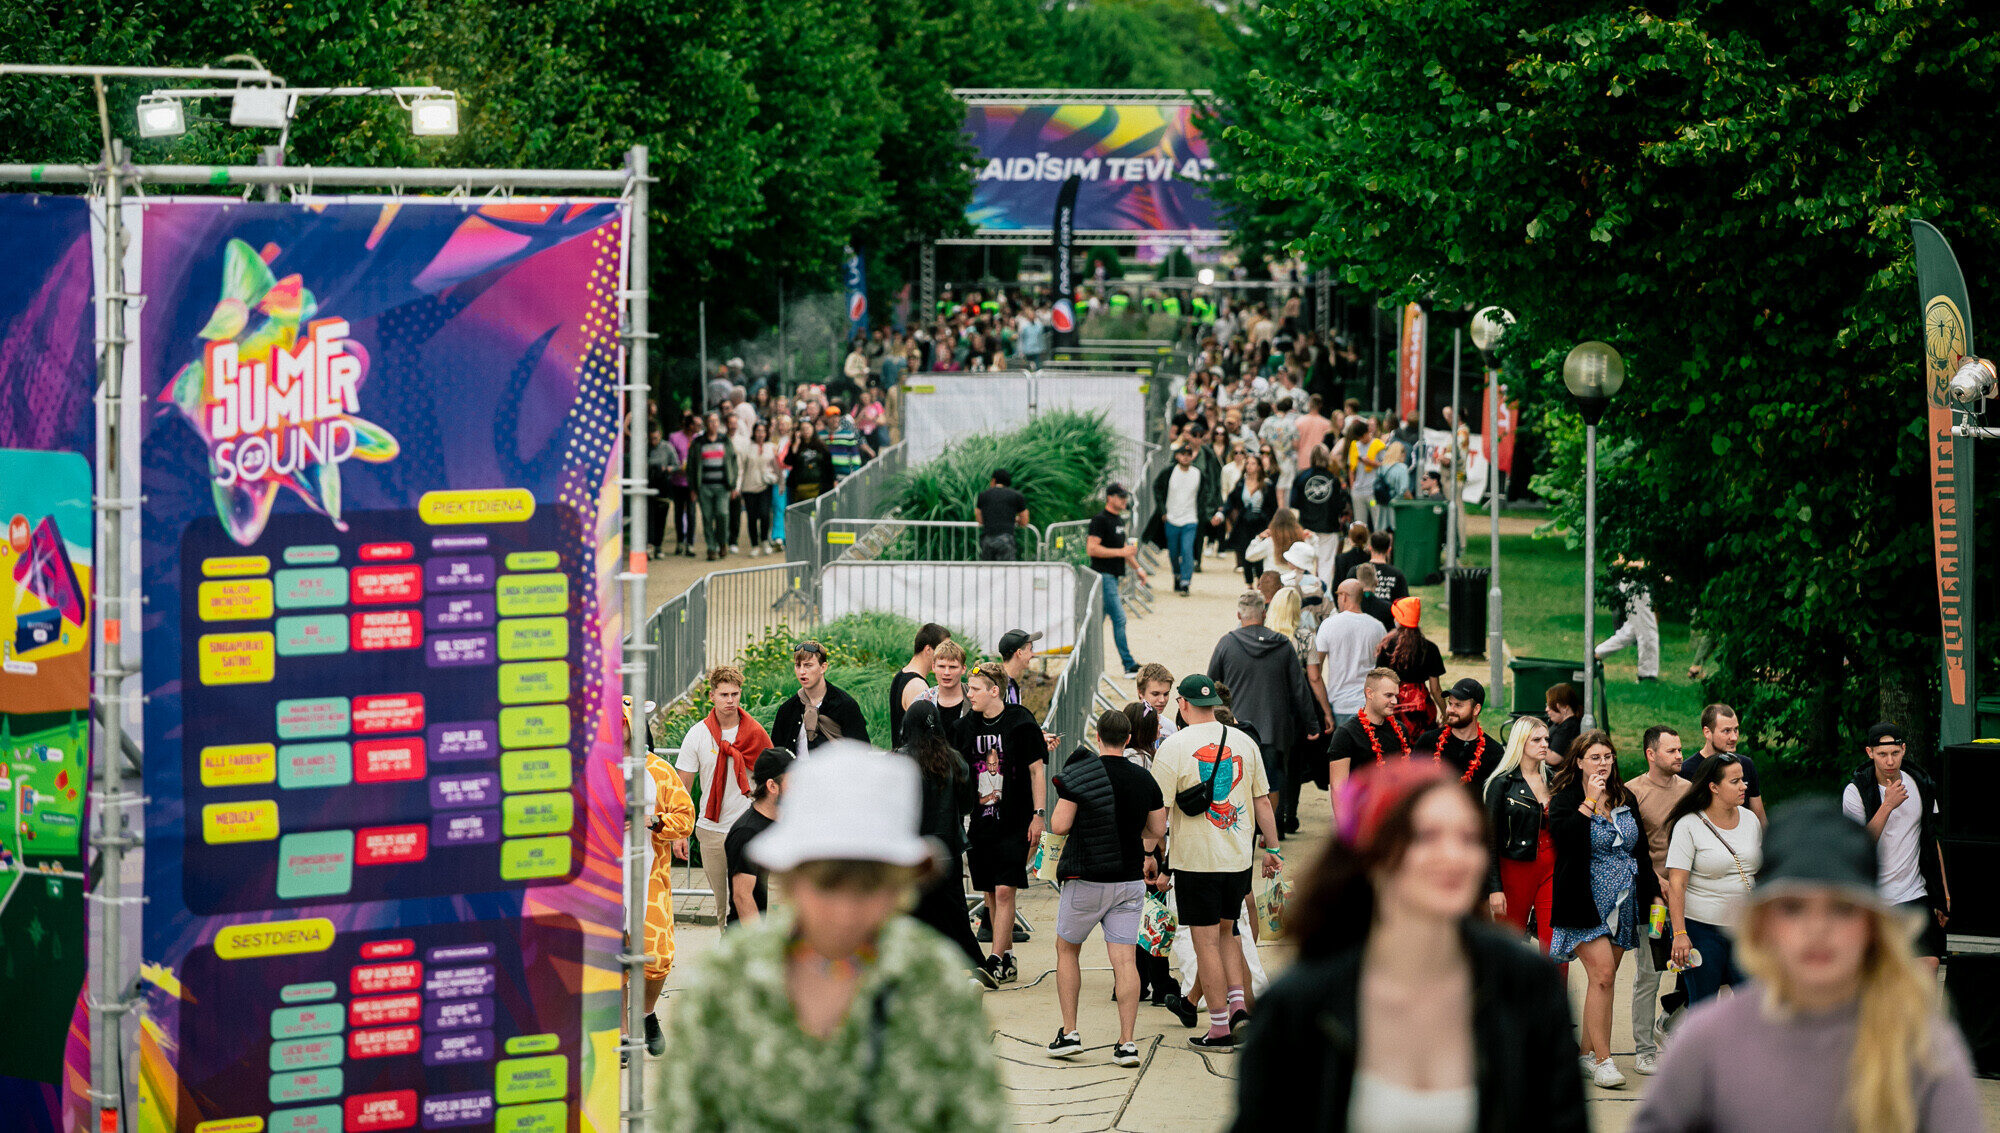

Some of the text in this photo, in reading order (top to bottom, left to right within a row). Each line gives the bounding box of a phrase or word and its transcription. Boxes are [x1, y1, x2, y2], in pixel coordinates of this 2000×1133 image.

[976, 152, 1100, 181] AIDĪSIM
[1105, 158, 1174, 181] TEVI
[212, 320, 361, 439] SUMMER
[215, 420, 357, 487] SOUND
[432, 499, 523, 515] PIEKTDIENA
[232, 929, 321, 949] SESTDIENA
